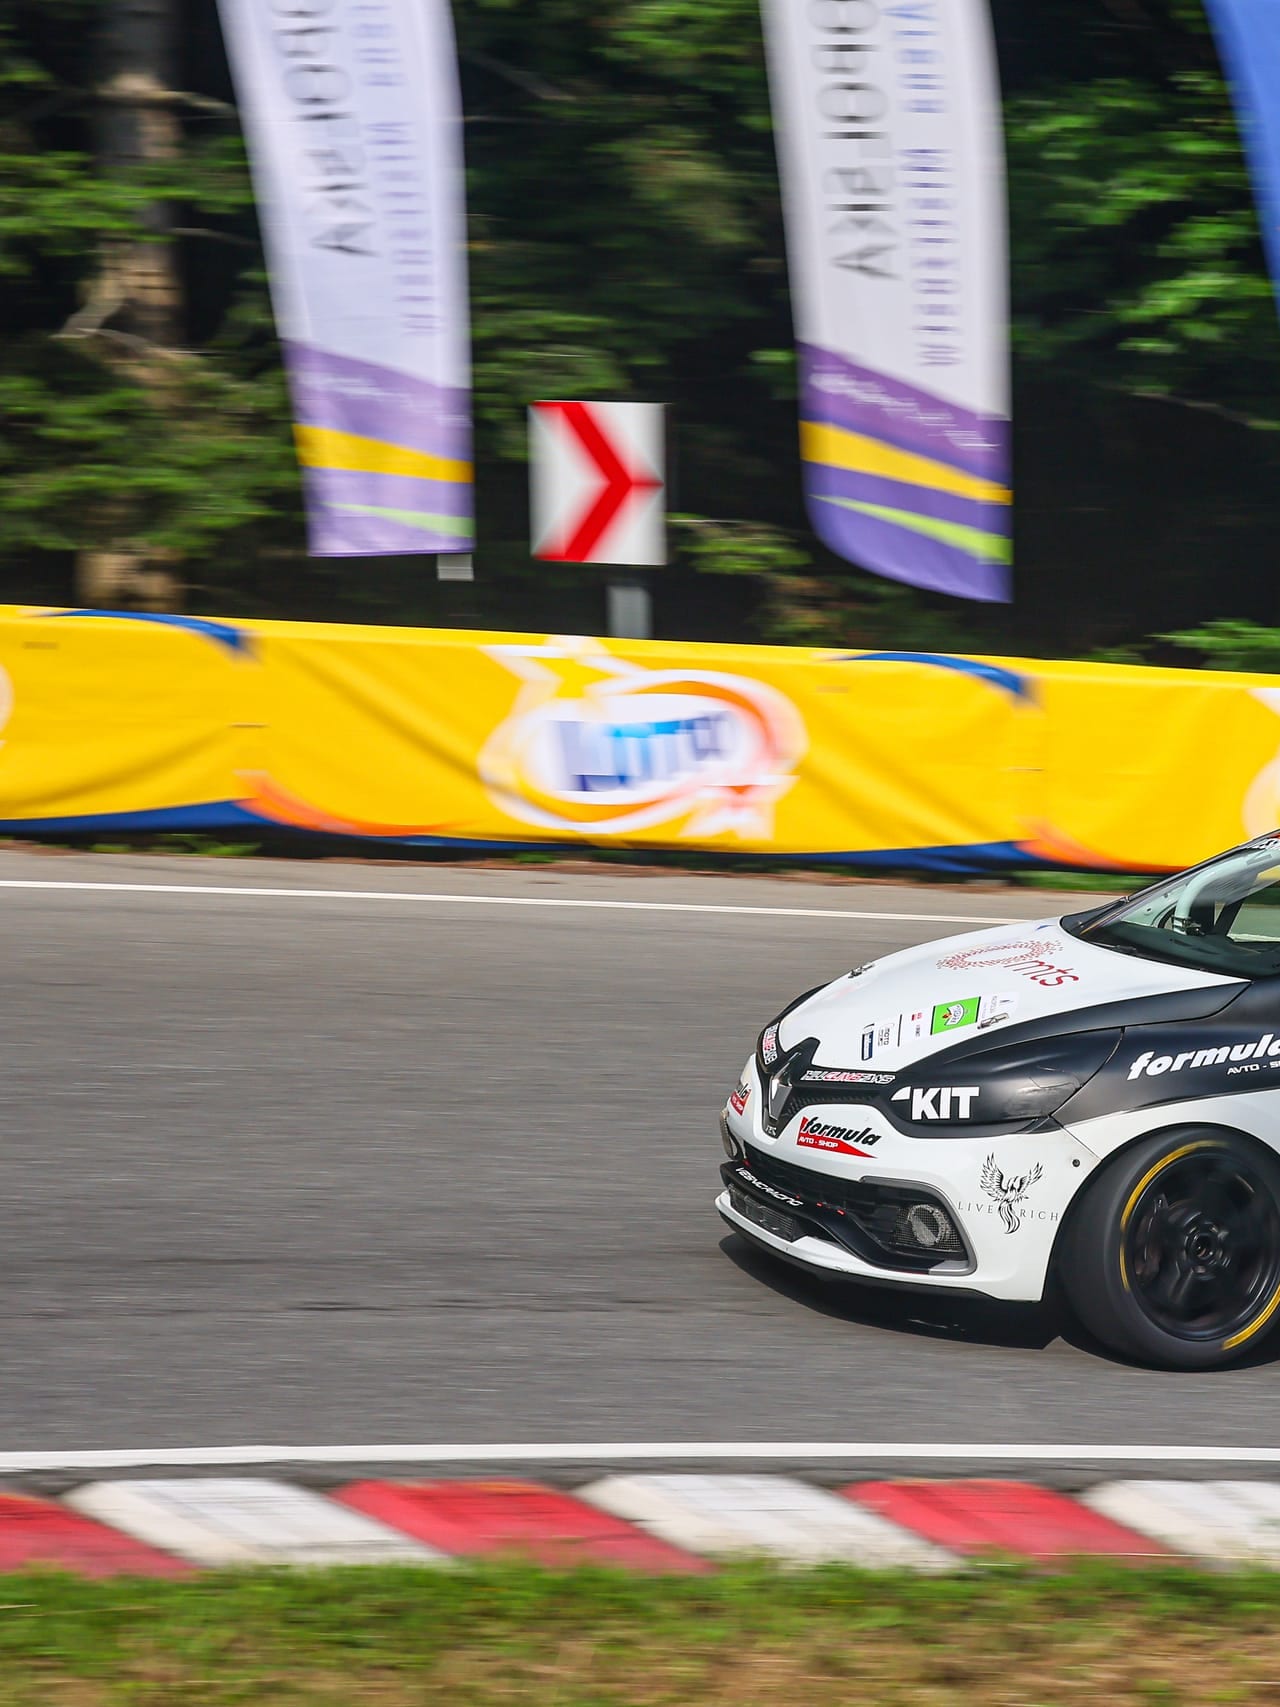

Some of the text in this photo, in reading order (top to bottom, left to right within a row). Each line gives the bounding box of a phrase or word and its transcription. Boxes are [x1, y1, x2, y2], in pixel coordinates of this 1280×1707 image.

[1003, 959, 1080, 987] mts
[1226, 1063, 1260, 1075] AVTO
[912, 1086, 980, 1121] KIT
[803, 1116, 881, 1146] formula
[818, 1139, 838, 1148] SHOP
[958, 1201, 1059, 1221] LIVE RICH
